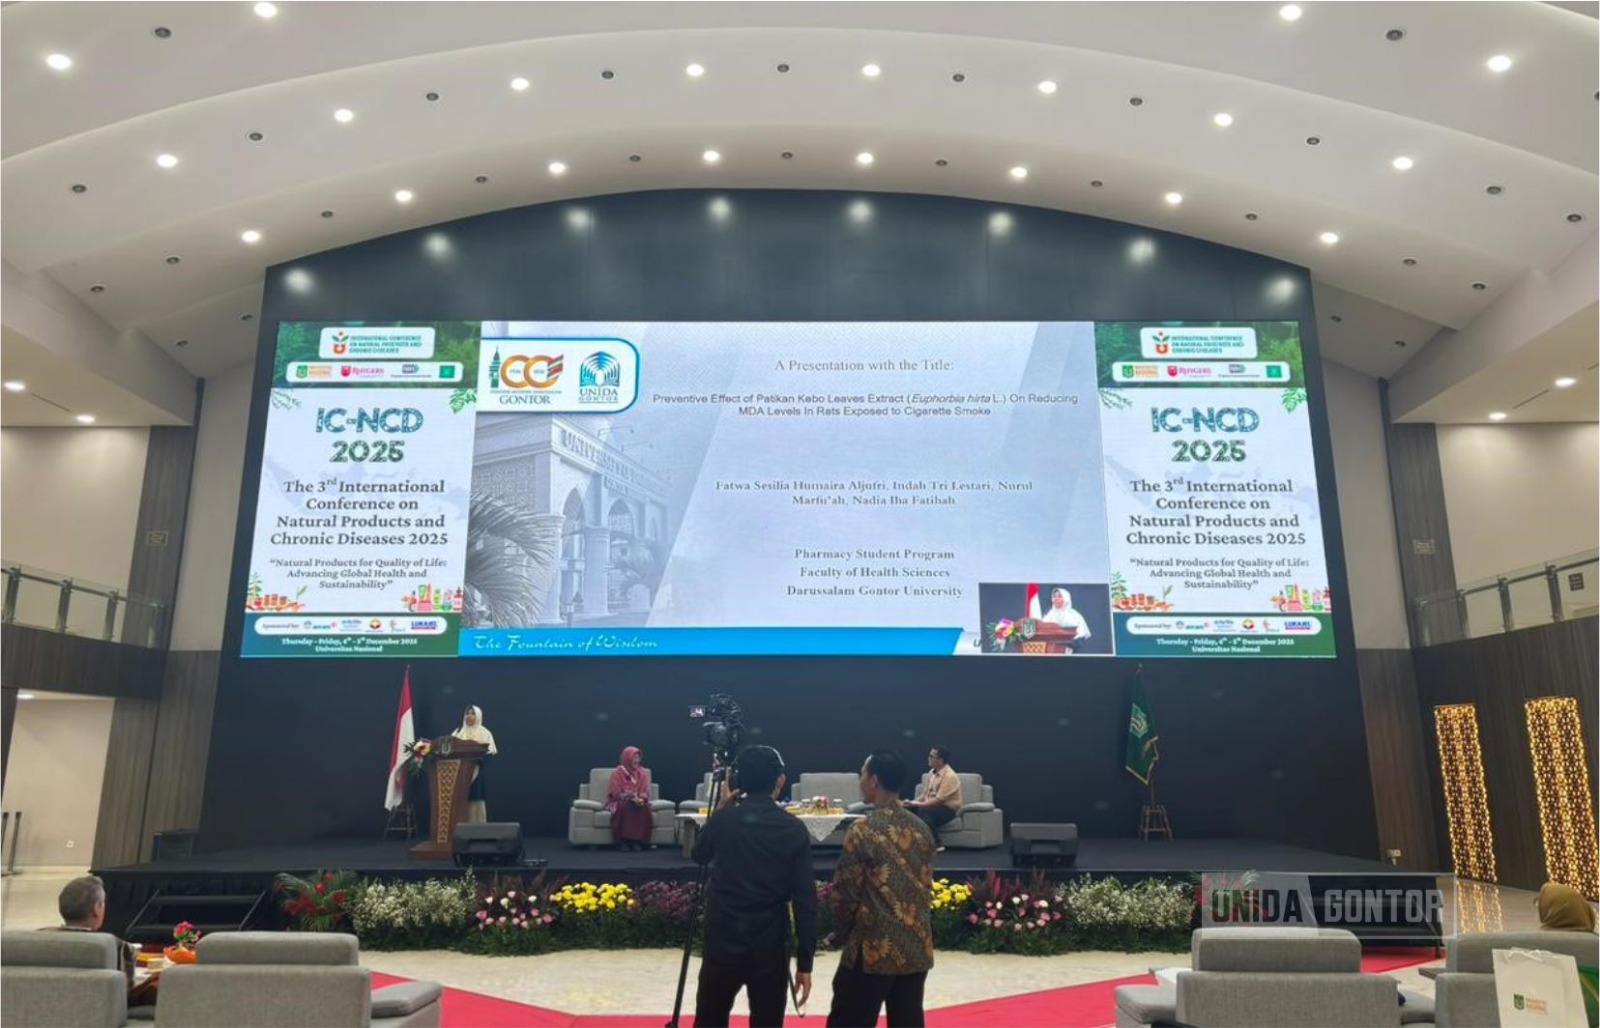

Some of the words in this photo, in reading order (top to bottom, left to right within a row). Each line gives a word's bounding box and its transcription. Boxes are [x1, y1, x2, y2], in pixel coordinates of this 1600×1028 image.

[775, 360, 785, 371] A
[789, 360, 864, 371] Presentation
[867, 360, 895, 371] with
[900, 360, 918, 371] the
[921, 360, 955, 371] Title:
[580, 388, 618, 396] UNIDA
[499, 395, 551, 405] GONTOR
[653, 394, 708, 404] Preventive
[711, 394, 741, 404] Effect
[743, 394, 754, 404] of
[757, 394, 795, 404] Patikan
[798, 394, 825, 404] Kebo
[828, 394, 864, 404] Leaves
[867, 394, 904, 404] Extract
[967, 394, 991, 404] hirta
[1010, 394, 1025, 404] On
[1028, 394, 1078, 406] Reducing
[738, 406, 765, 416] MDA
[767, 406, 801, 416] Levels
[804, 406, 814, 416] In
[817, 406, 840, 416] Rats
[843, 406, 888, 418] Exposed
[891, 406, 901, 416] to
[904, 406, 952, 418] Cigarette
[954, 406, 991, 416] Smoke
[315, 407, 424, 433] IC-NCD
[1151, 407, 1260, 433] IC-NCD
[329, 440, 405, 462] 2025
[1171, 440, 1247, 462] 2025
[283, 480, 314, 493] The
[339, 480, 445, 493] International
[716, 481, 750, 490] Fatwa
[754, 481, 790, 490] Sesilia
[793, 481, 845, 490] Humaira
[848, 481, 888, 492] Aljufri,
[892, 481, 926, 490] Indah
[930, 481, 948, 490] Tri
[952, 481, 994, 492] Lestari,
[998, 481, 1033, 490] Nurul
[1129, 480, 1161, 493] The
[1186, 480, 1293, 493] International
[306, 498, 395, 510] Conference
[399, 501, 419, 510] on
[852, 496, 887, 505] Nadia
[912, 496, 955, 505] Fatihah
[1156, 498, 1247, 510] Conference
[1250, 501, 1270, 510] on
[277, 515, 337, 527] Natural
[341, 515, 411, 527] Products
[415, 515, 445, 527] and
[1129, 515, 1191, 527] Natural
[1195, 515, 1266, 527] Products
[1270, 515, 1300, 527] and
[270, 532, 334, 545] Chronic
[338, 532, 405, 545] Diseases
[409, 532, 448, 545] 2025
[1126, 532, 1191, 545] Chronic
[1195, 532, 1263, 545] Diseases
[1266, 532, 1306, 545] 2025
[794, 549, 852, 562] Pharmacy
[856, 549, 900, 559] Student
[904, 549, 955, 562] Program
[314, 558, 358, 566] Products
[359, 558, 374, 566] for
[376, 558, 411, 568] Quality
[413, 558, 424, 566] of
[426, 558, 447, 566] Life:
[1175, 558, 1219, 566] Products
[1221, 558, 1236, 566] for
[1237, 558, 1273, 568] Quality
[1275, 558, 1286, 566] of
[1287, 558, 1310, 566] Life:
[287, 569, 338, 579] Advancing
[340, 569, 372, 578] Global
[374, 569, 406, 578] Health
[408, 569, 427, 578] and
[800, 567, 842, 580] Faculty
[846, 567, 857, 577] of
[860, 567, 899, 577] Health
[902, 567, 951, 577] Sciences
[1150, 569, 1202, 579] Advancing
[1204, 569, 1236, 578] Global
[1238, 569, 1271, 578] Health
[1273, 569, 1291, 578] and
[787, 585, 855, 596] Darussalam
[859, 585, 901, 596] Gontor
[904, 585, 962, 598] University
[282, 638, 313, 646] Thursday
[474, 635, 500, 649] The
[506, 634, 573, 651] Fountain
[578, 636, 594, 652] of
[595, 634, 658, 648] Wisdom
[1157, 638, 1188, 646] Thursday
